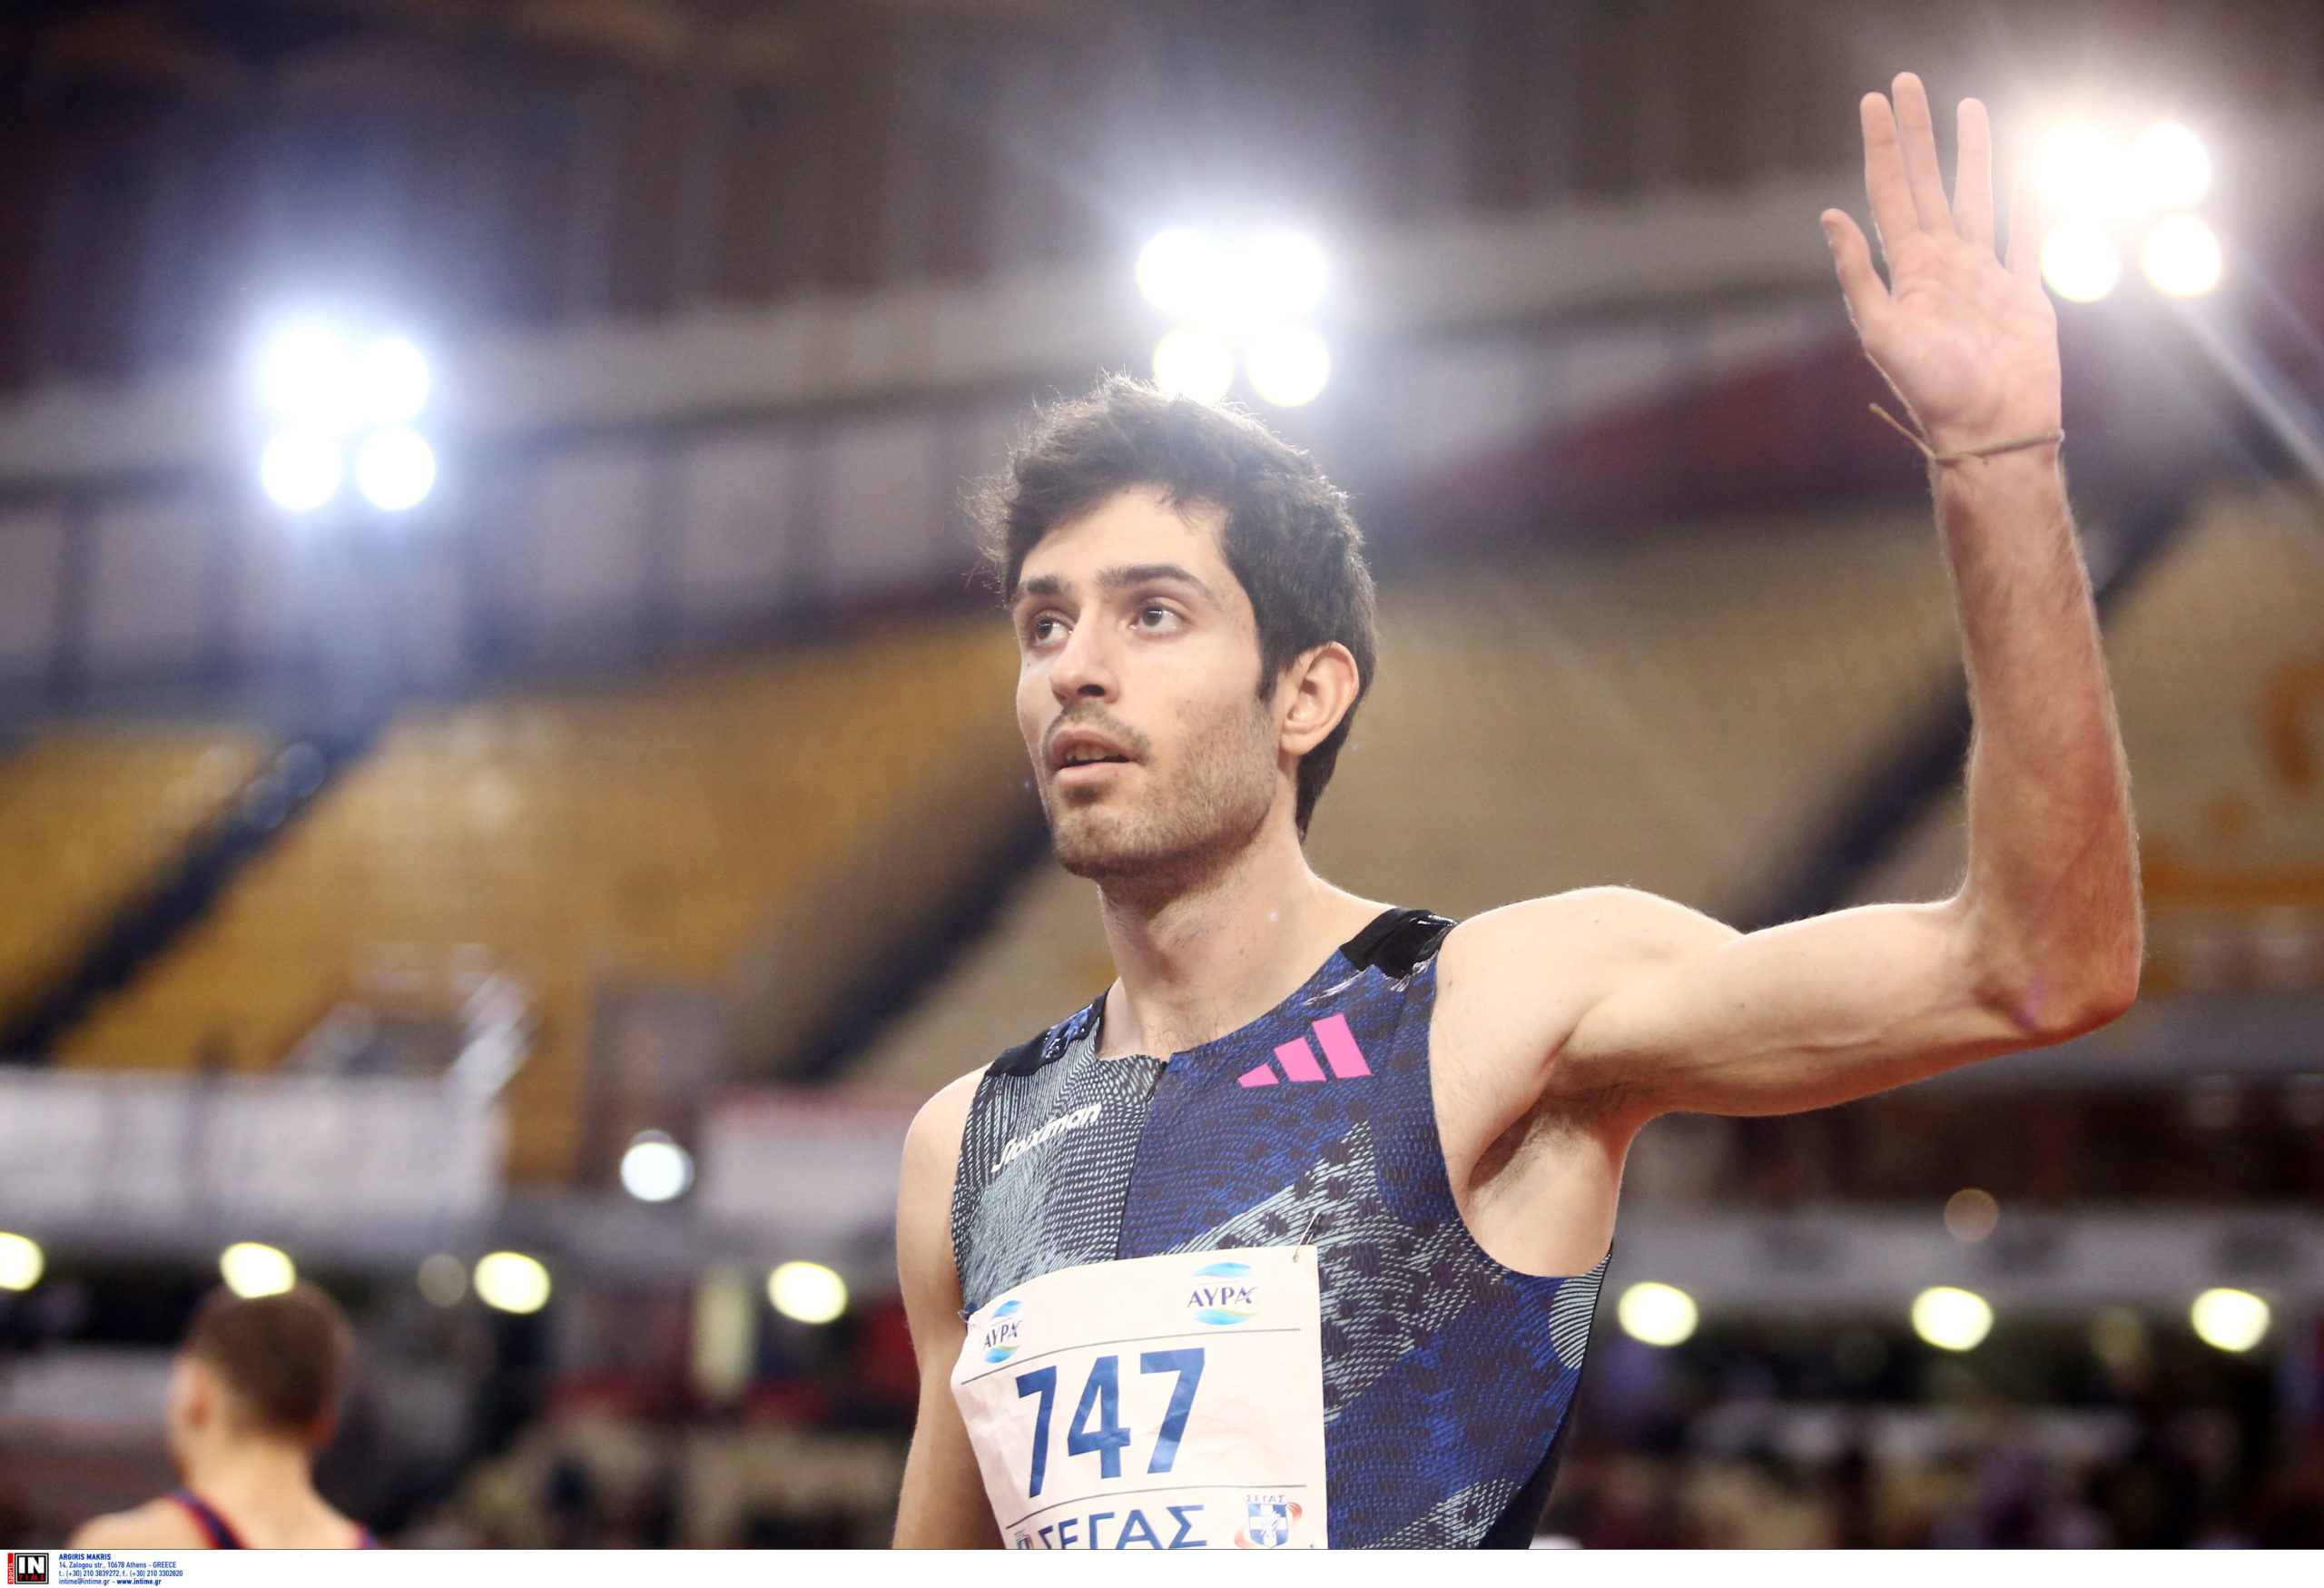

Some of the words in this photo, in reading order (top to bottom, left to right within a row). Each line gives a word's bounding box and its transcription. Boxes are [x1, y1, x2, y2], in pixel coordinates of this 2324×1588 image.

[1187, 1286, 1258, 1307] ΑΥΡΑ
[1016, 1347, 1205, 1498] 747
[1246, 1494, 1285, 1504] ΣΕΓΑΣ
